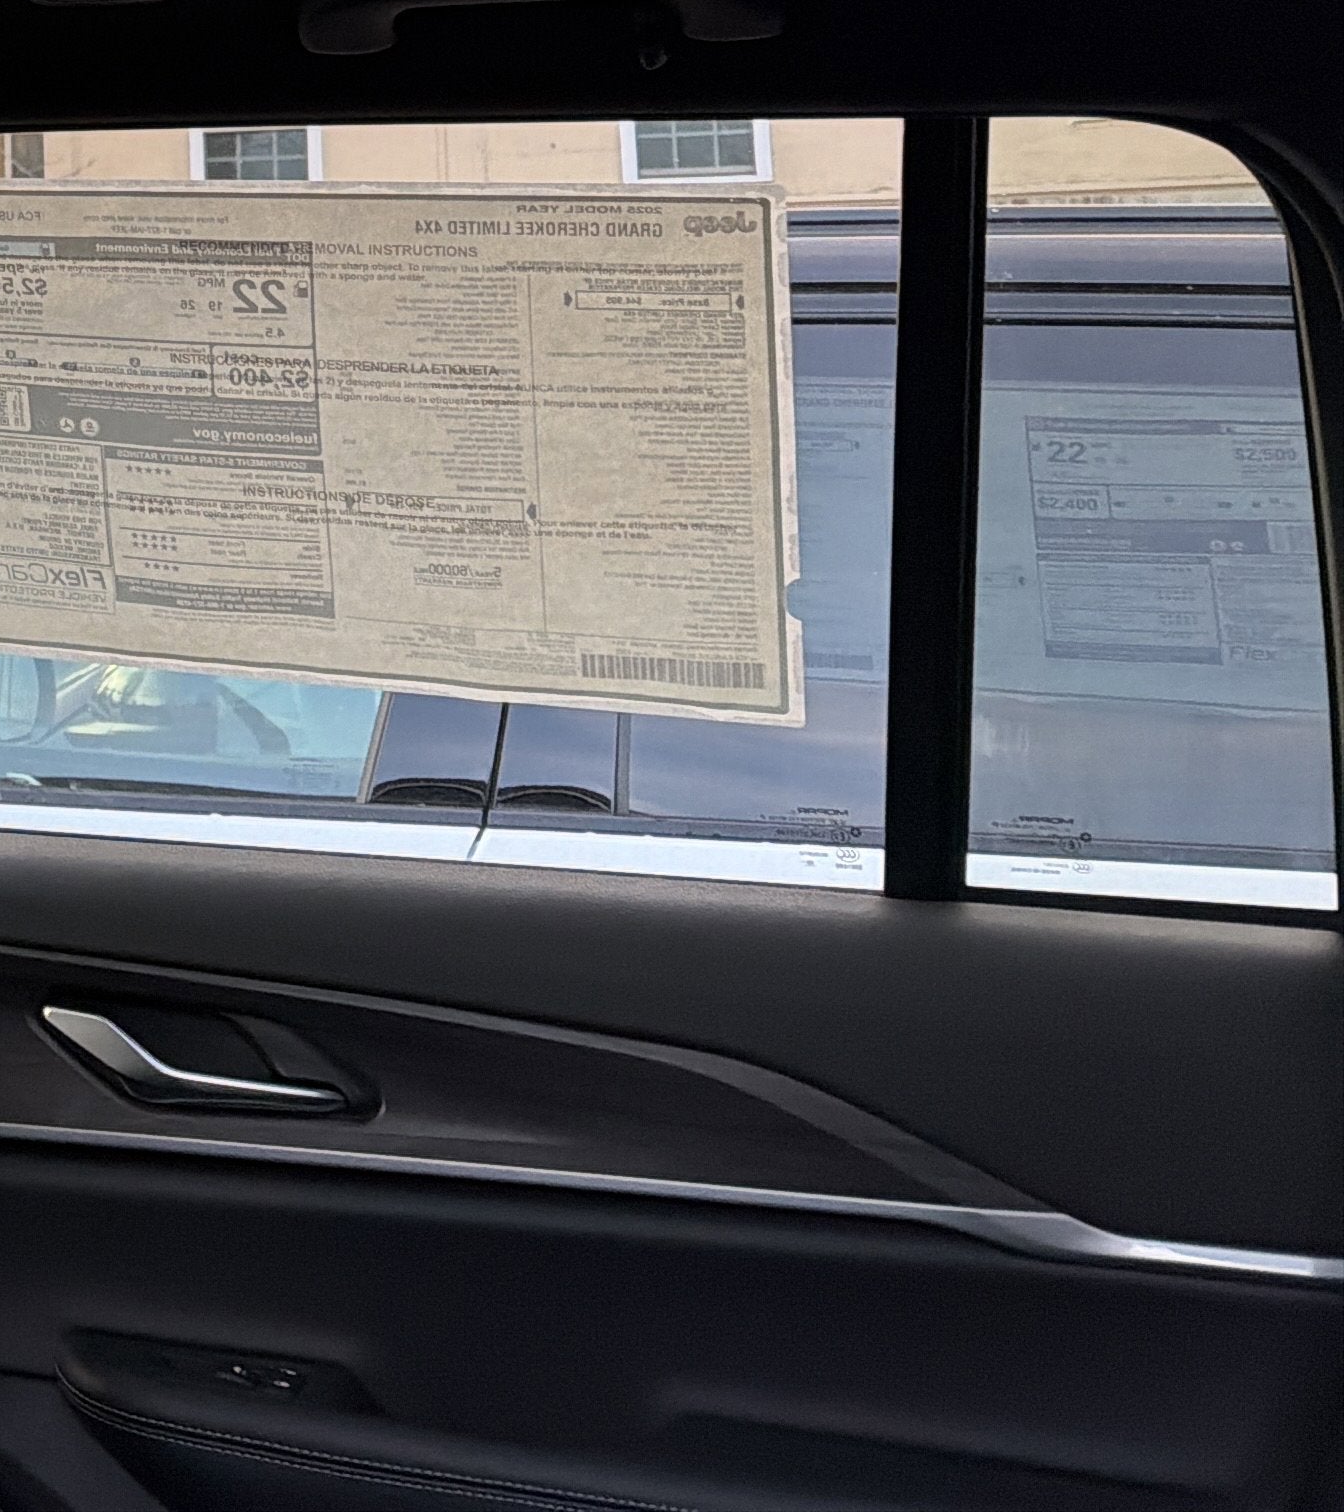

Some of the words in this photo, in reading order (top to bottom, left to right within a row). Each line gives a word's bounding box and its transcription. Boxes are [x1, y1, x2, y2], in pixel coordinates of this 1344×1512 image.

[368, 244, 478, 257] INSTRUCTIONS
[314, 262, 339, 271] other
[341, 262, 369, 273] sharp
[408, 263, 420, 271] To
[462, 264, 480, 272] this
[339, 273, 374, 282] sponge
[377, 273, 399, 281] and
[275, 357, 312, 369] PARA
[317, 360, 409, 374] DESPRENDER
[412, 363, 430, 374] LA
[432, 363, 499, 376] ETIQUETA
[556, 384, 588, 393] utilice
[590, 384, 659, 394] instrumentos
[364, 393, 401, 403] residuo
[404, 394, 416, 403] de
[543, 398, 575, 409] limpie
[577, 400, 598, 408] con
[599, 400, 619, 409] una
[1046, 440, 1088, 465] 22
[243, 485, 350, 503] INSTRUCTIONS
[600, 521, 626, 529] cette
[608, 531, 621, 539] de
[1228, 646, 1277, 662] Flex
